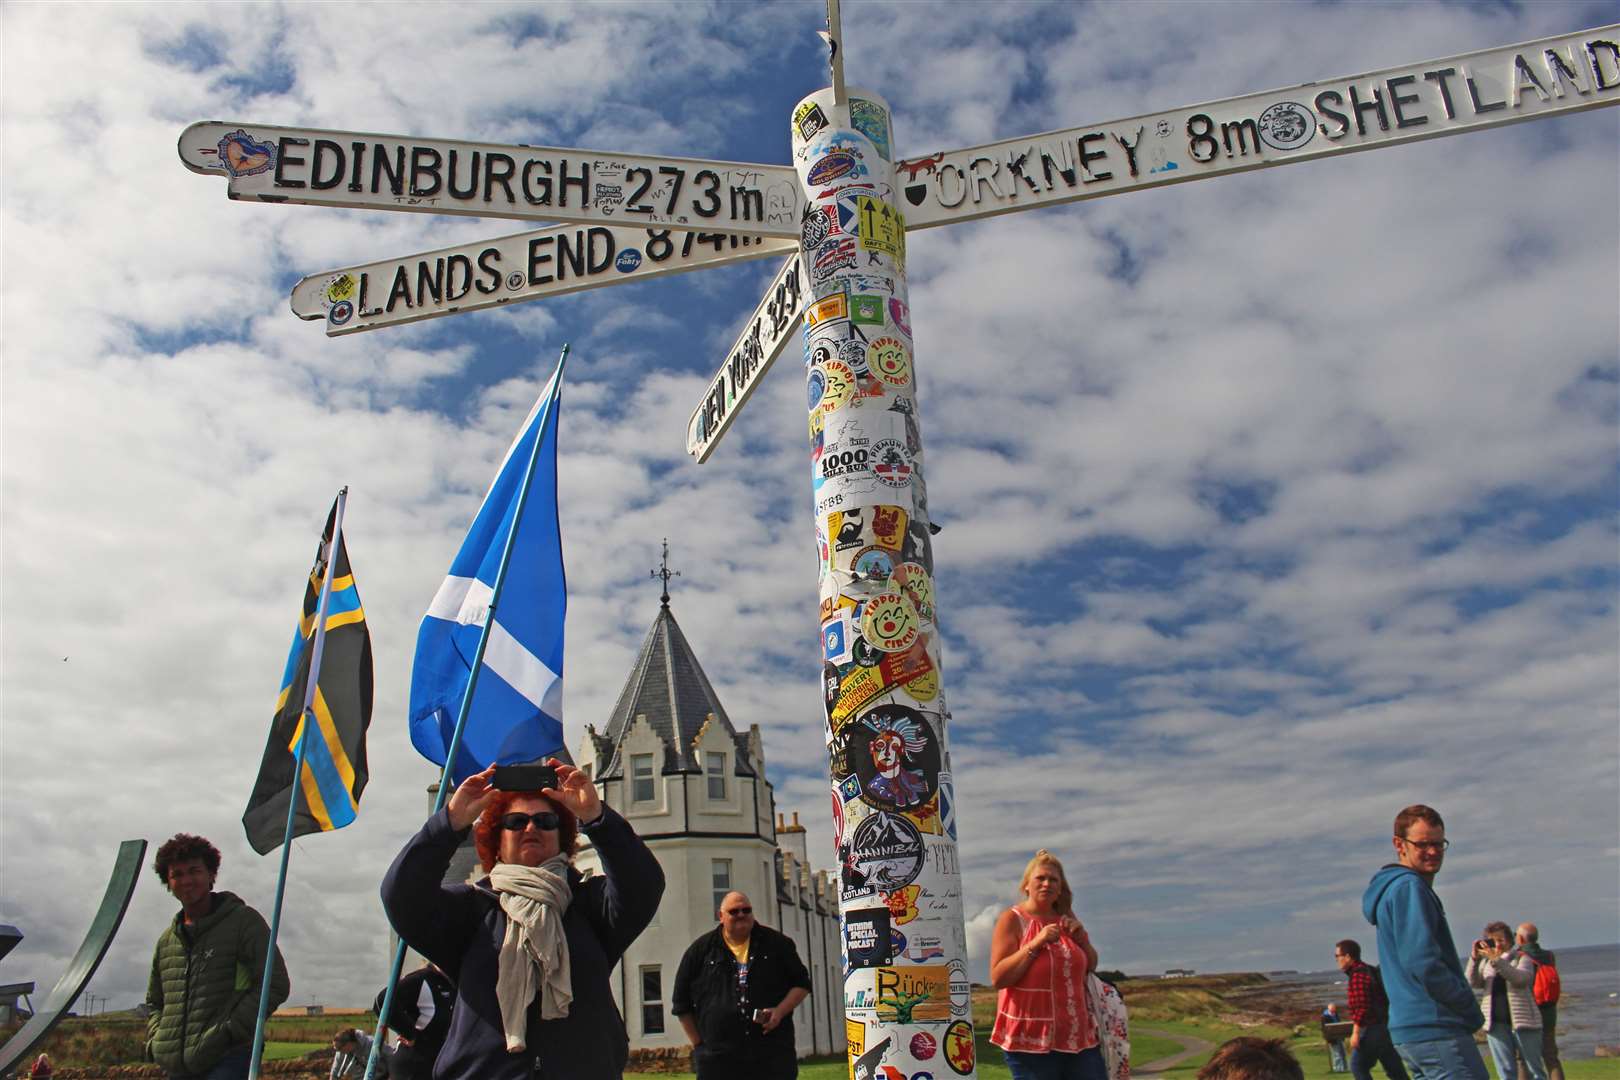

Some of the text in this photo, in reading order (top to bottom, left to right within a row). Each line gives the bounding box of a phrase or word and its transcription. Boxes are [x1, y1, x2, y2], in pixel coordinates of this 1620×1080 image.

[935, 40, 1620, 208] ORKNEY 8m SHETLAND
[273, 136, 764, 222] EDINBURGH 273m
[358, 248, 501, 318] LANDS
[528, 227, 616, 286] END
[702, 376, 726, 443] NEW
[728, 317, 764, 400] YORK
[822, 449, 868, 472] 1000
[846, 463, 868, 473] RUN
[865, 594, 902, 616] ZIPPOS
[884, 626, 916, 648] CIRCUS
[854, 842, 920, 860] HANNIBAL
[842, 886, 871, 900] SCOTLAND
